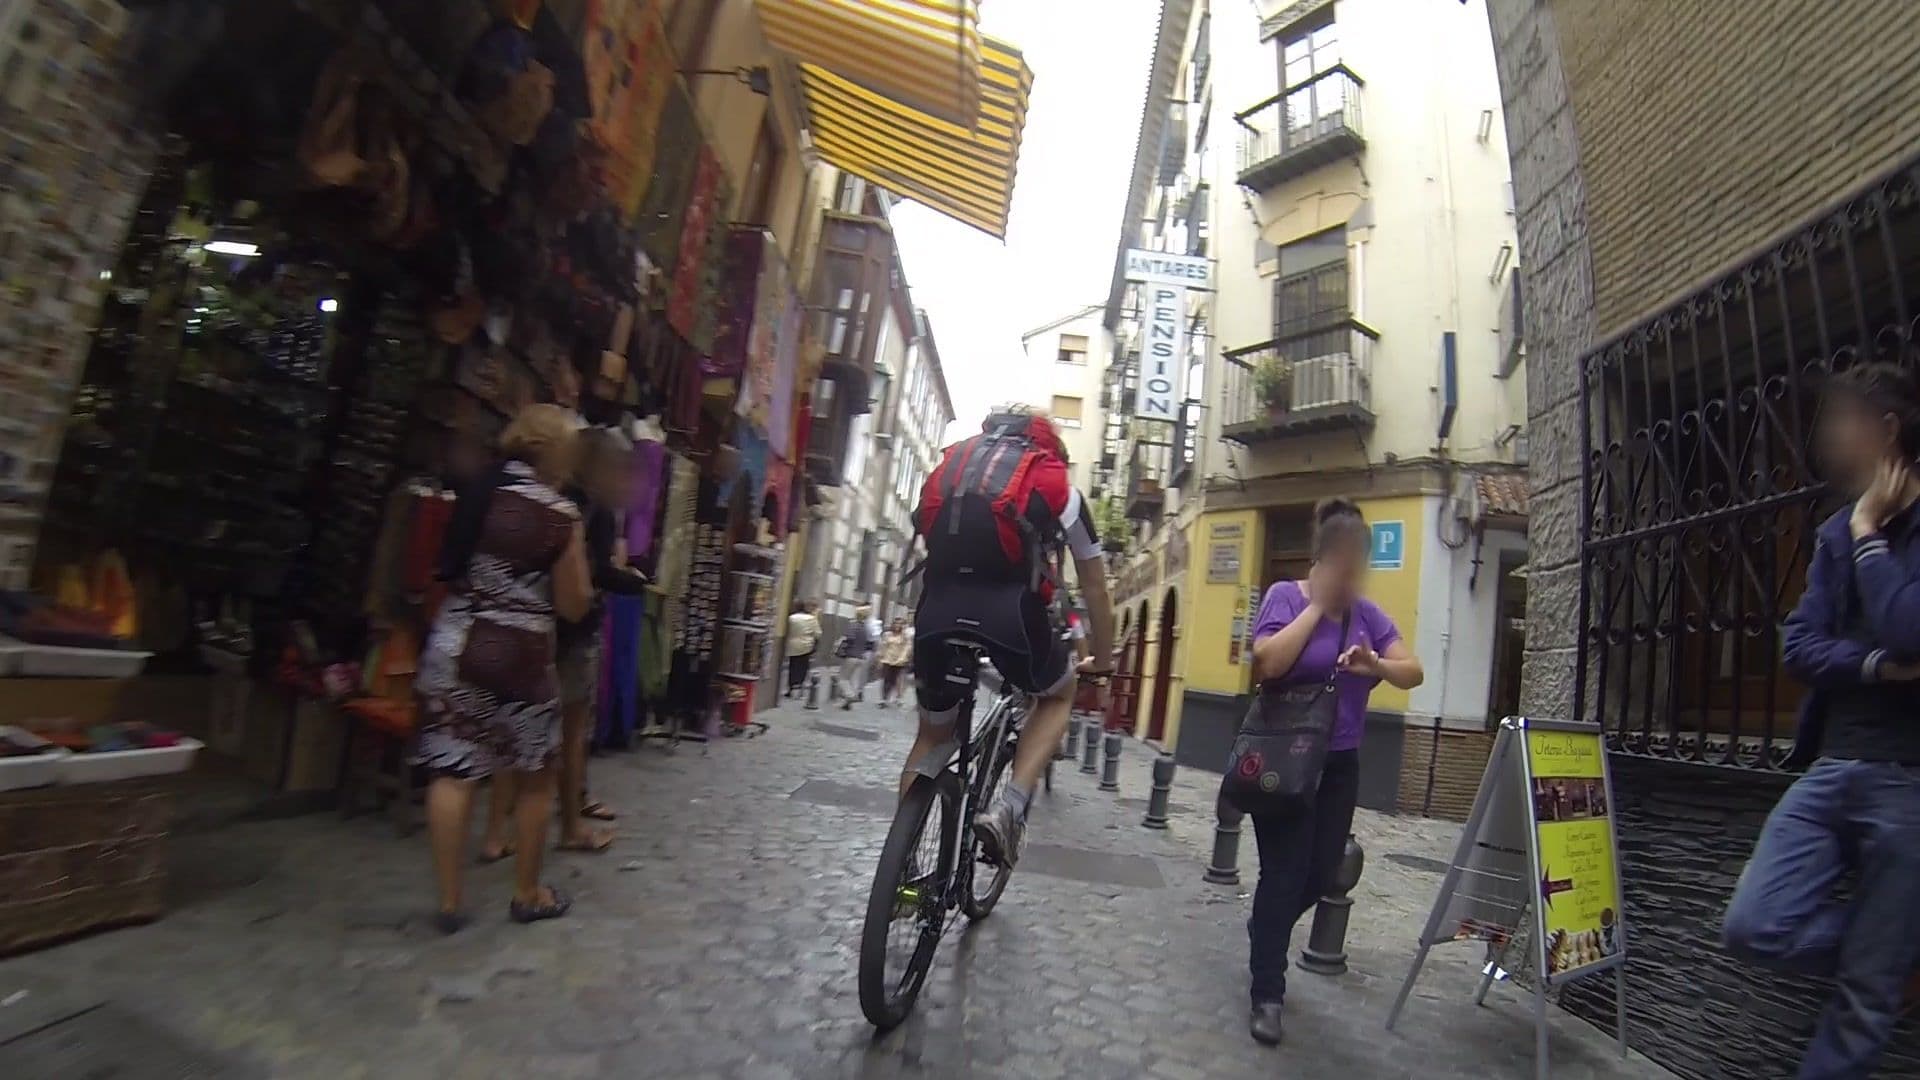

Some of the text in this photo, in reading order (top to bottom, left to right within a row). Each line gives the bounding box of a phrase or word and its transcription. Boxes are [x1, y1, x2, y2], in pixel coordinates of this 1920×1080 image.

[1130, 257, 1208, 280] ANTARES
[1145, 289, 1177, 415] PENSION
[1379, 530, 1395, 553] P
